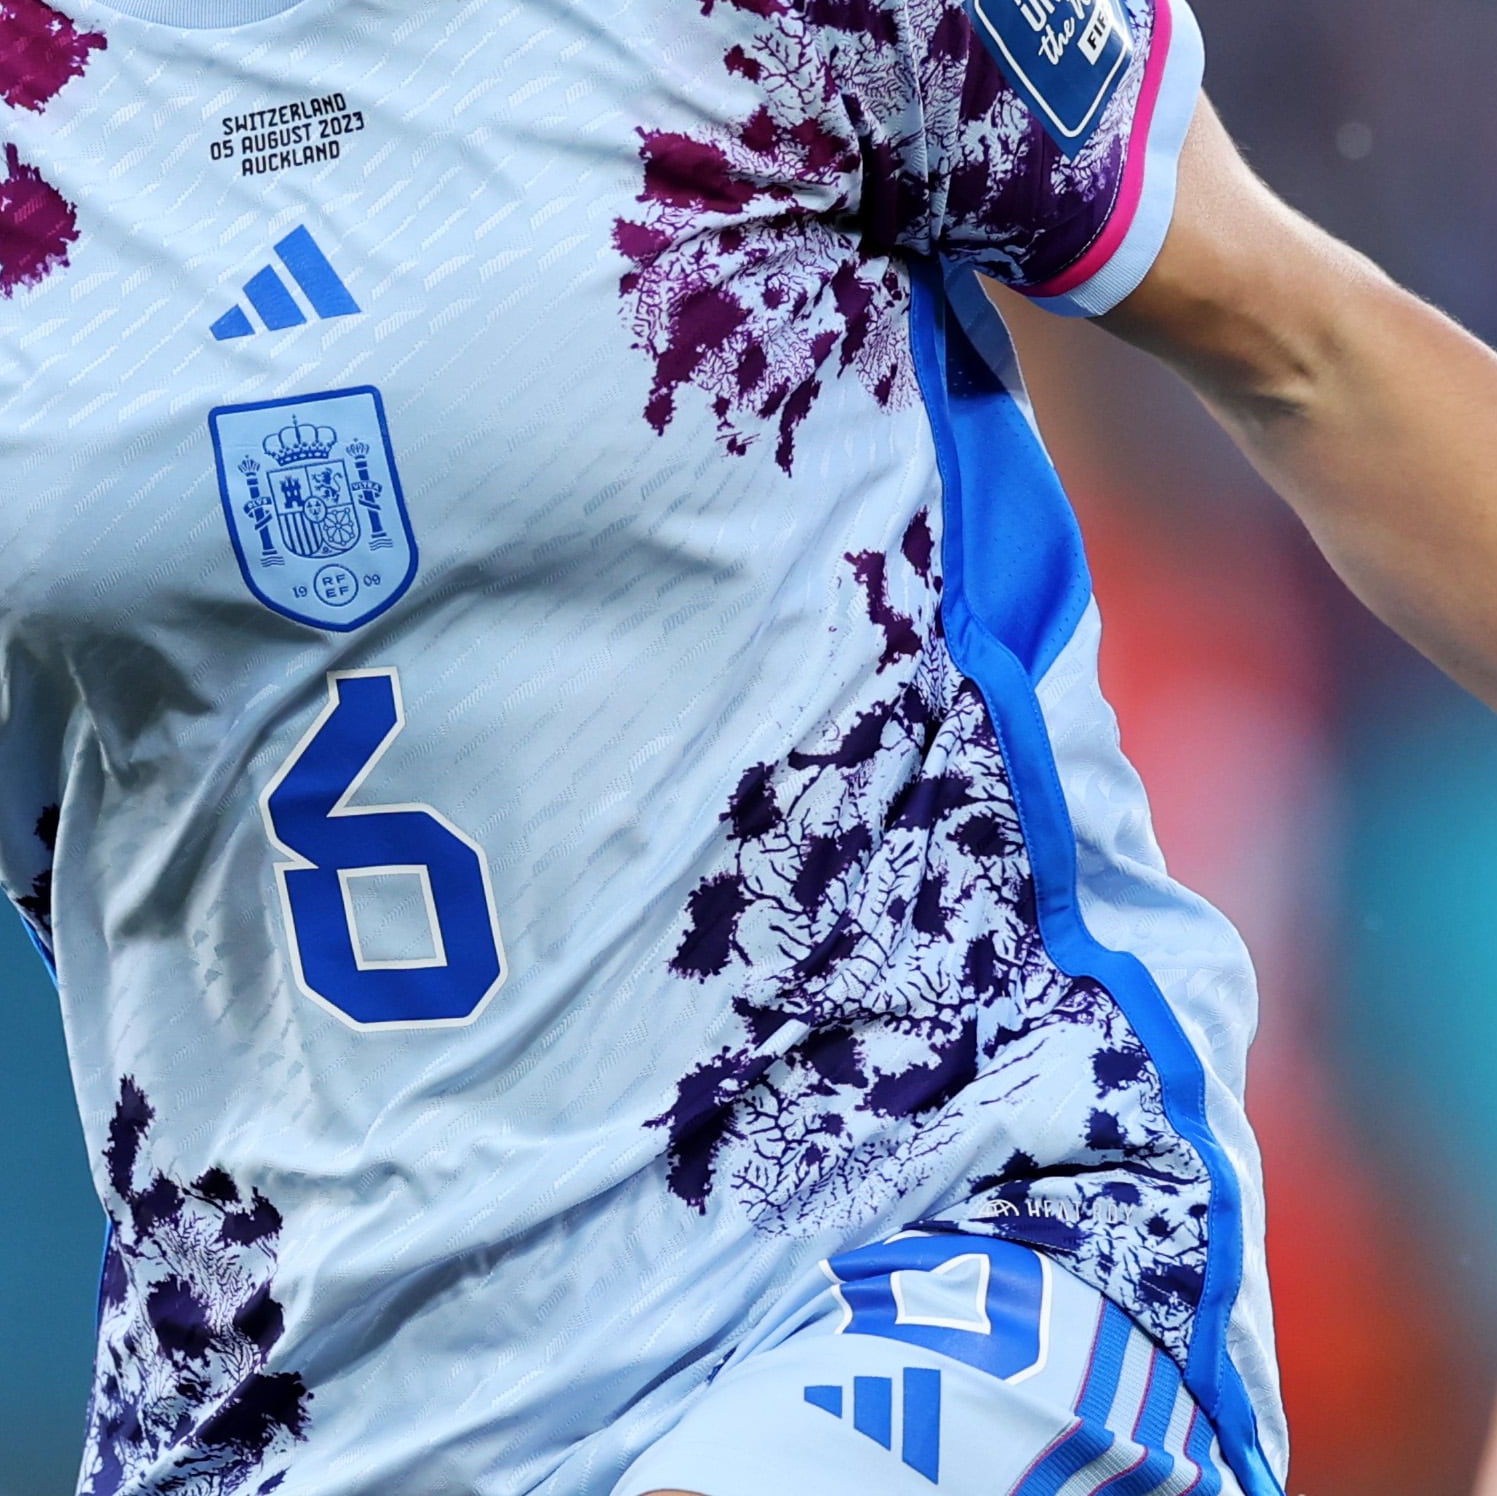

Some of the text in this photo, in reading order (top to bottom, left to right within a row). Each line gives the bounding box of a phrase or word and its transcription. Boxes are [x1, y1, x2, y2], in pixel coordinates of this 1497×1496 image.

[1038, 17, 1075, 66] the
[210, 111, 365, 161] 05 AUGUST 2023
[222, 92, 347, 136] SWITZERLAND
[242, 140, 340, 176] AUCKLAND
[292, 585, 308, 599] 19
[363, 574, 381, 588] 09
[259, 666, 509, 1032] 6
